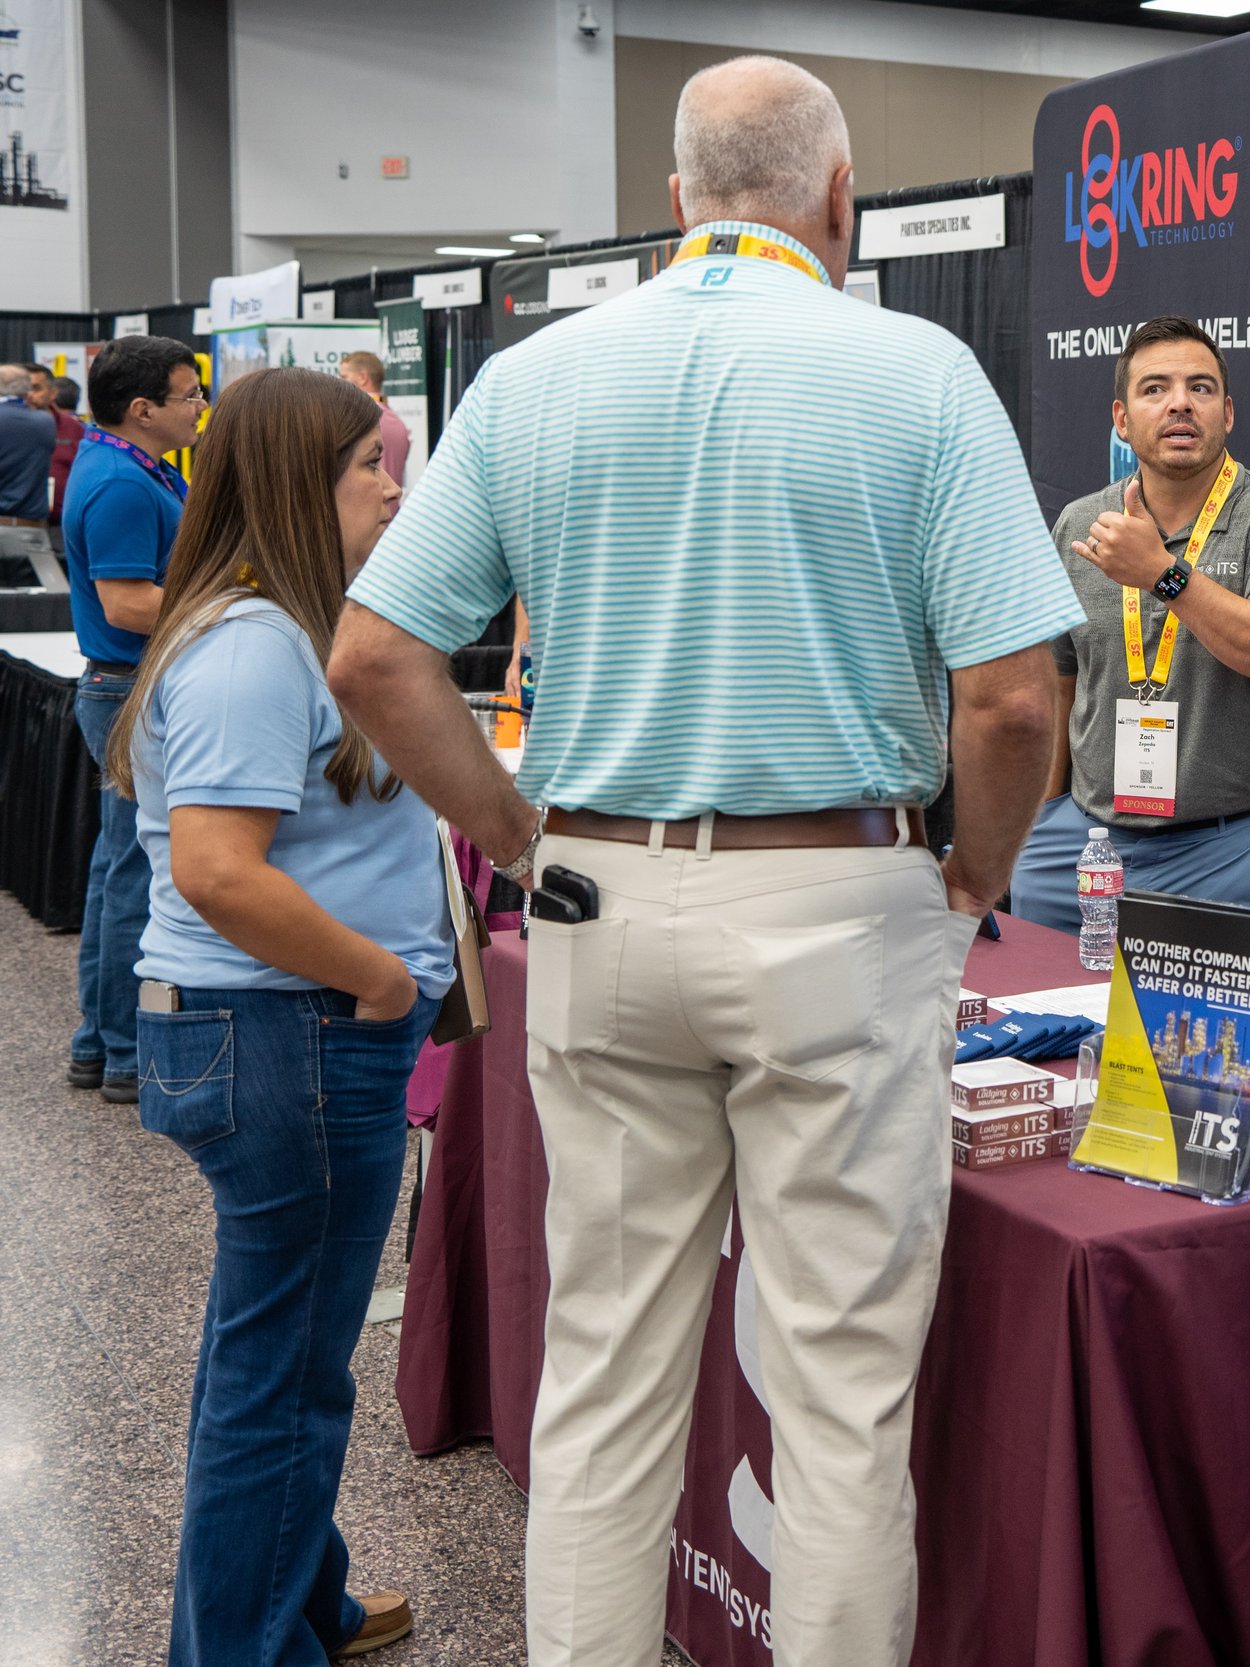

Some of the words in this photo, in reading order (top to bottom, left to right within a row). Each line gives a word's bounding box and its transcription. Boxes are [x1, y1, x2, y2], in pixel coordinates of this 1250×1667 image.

[1064, 138, 1238, 248] LOKRING
[900, 220, 926, 237] PARTNERS
[927, 216, 959, 235] SPECIALTIES
[1150, 221, 1235, 246] TECHNOLOGY
[700, 267, 733, 286] FJ
[1047, 329, 1081, 360] THE
[1084, 324, 1132, 357] ONLY
[1217, 562, 1238, 575] ITS
[1123, 799, 1164, 811] SPONSOR
[1123, 937, 1145, 953] NO
[1147, 941, 1191, 961] OTHER
[1131, 956, 1160, 974] CAN
[1163, 962, 1185, 978] DO
[1189, 965, 1203, 981] IT
[1137, 974, 1179, 996] SAFER
[1182, 982, 1203, 1000] OR
[962, 1001, 982, 1016] ITS
[1109, 1061, 1126, 1070] BLAST
[1127, 1065, 1144, 1075] TENTS
[954, 1086, 968, 1106] ITS
[976, 1088, 1007, 1101] Lodging
[1023, 1081, 1049, 1101] ITS
[978, 1098, 1006, 1106] SOLUTIONS
[953, 1121, 969, 1140] ITS
[979, 1122, 1009, 1134] Lodging
[1024, 1114, 1049, 1134] ITS
[1188, 1110, 1240, 1152] ITS
[975, 1146, 1006, 1158] Lodging
[1021, 1138, 1046, 1158] ITS
[977, 1155, 1004, 1165] SOLUTIONS
[683, 1539, 731, 1611] TENT
